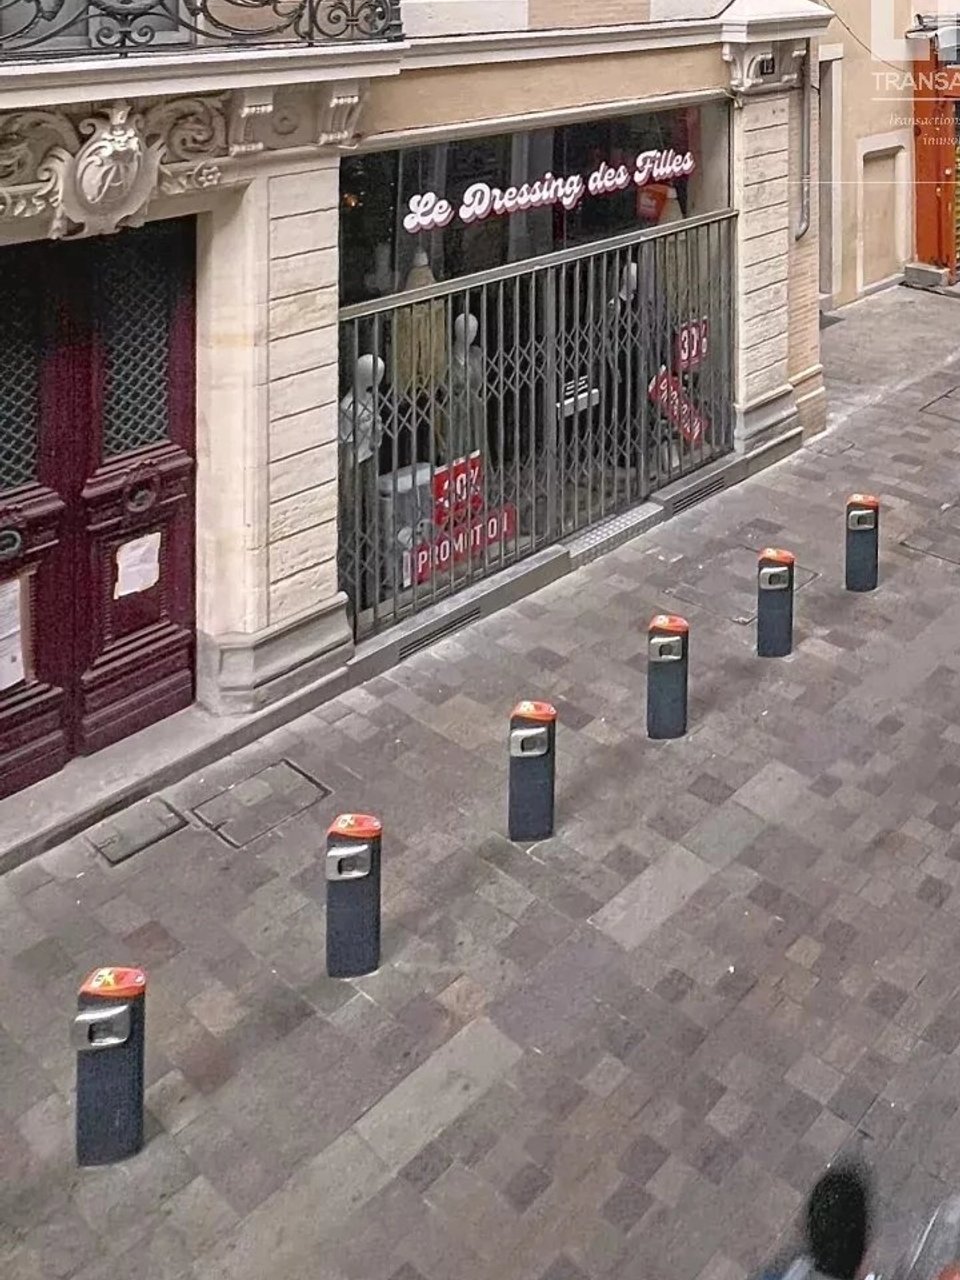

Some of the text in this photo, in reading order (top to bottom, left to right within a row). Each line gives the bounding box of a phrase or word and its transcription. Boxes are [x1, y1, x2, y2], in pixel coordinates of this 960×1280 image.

[403, 148, 696, 233] Le Dressing des Filles
